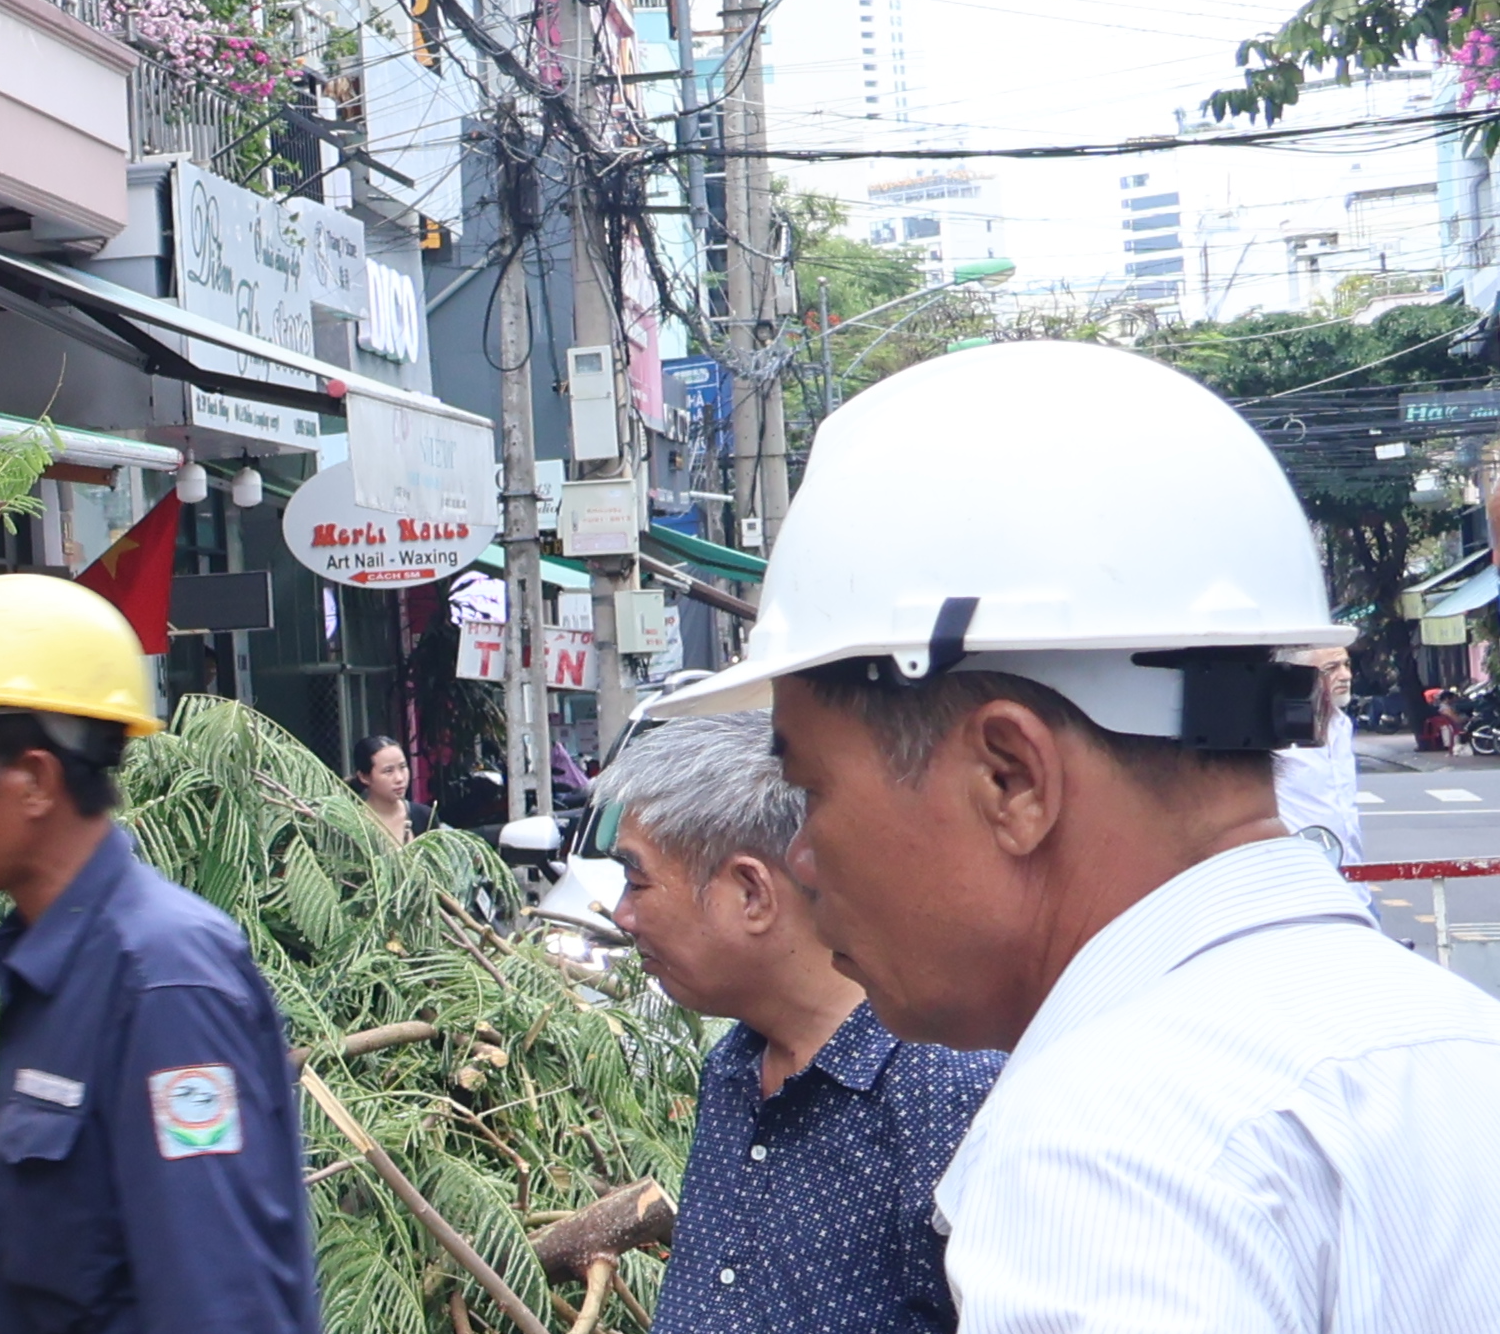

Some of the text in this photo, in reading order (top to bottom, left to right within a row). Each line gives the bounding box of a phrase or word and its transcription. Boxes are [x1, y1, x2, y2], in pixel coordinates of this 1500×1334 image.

[327, 554, 350, 569] Art
[355, 552, 384, 568] Nail
[399, 548, 458, 566] Waxing
[367, 570, 401, 582] CÁCH
